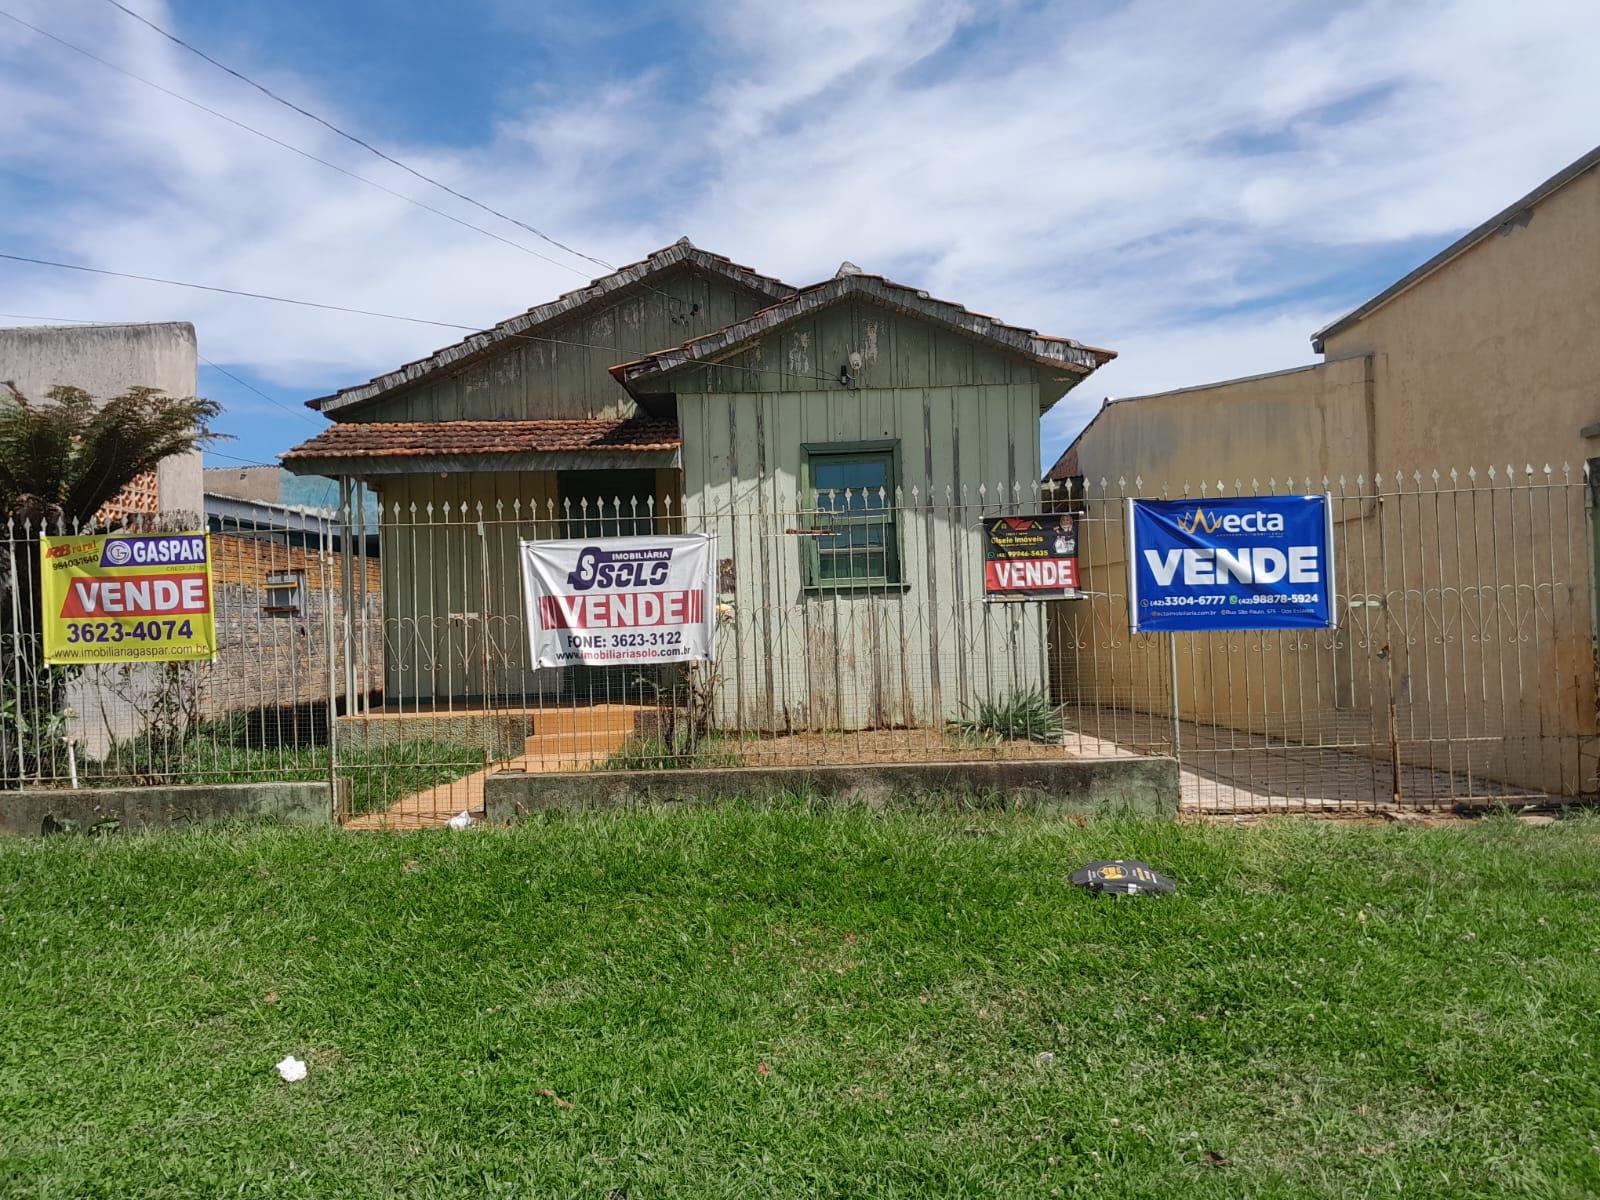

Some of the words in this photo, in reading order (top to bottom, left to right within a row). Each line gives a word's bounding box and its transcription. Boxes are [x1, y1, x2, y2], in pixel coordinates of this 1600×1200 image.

[133, 539, 205, 563] GASPAR
[611, 550, 670, 561] IMOBILIÁRIA
[995, 560, 1072, 587] VENDE
[1143, 546, 1320, 586] VENDE
[75, 579, 204, 613] VENDE
[558, 591, 685, 629] VENDE
[67, 619, 193, 644] 3623-4074
[567, 635, 607, 649] FONE:
[611, 631, 682, 648] 3623-3122
[556, 645, 691, 661] www.imobiliariasolo.com.br
